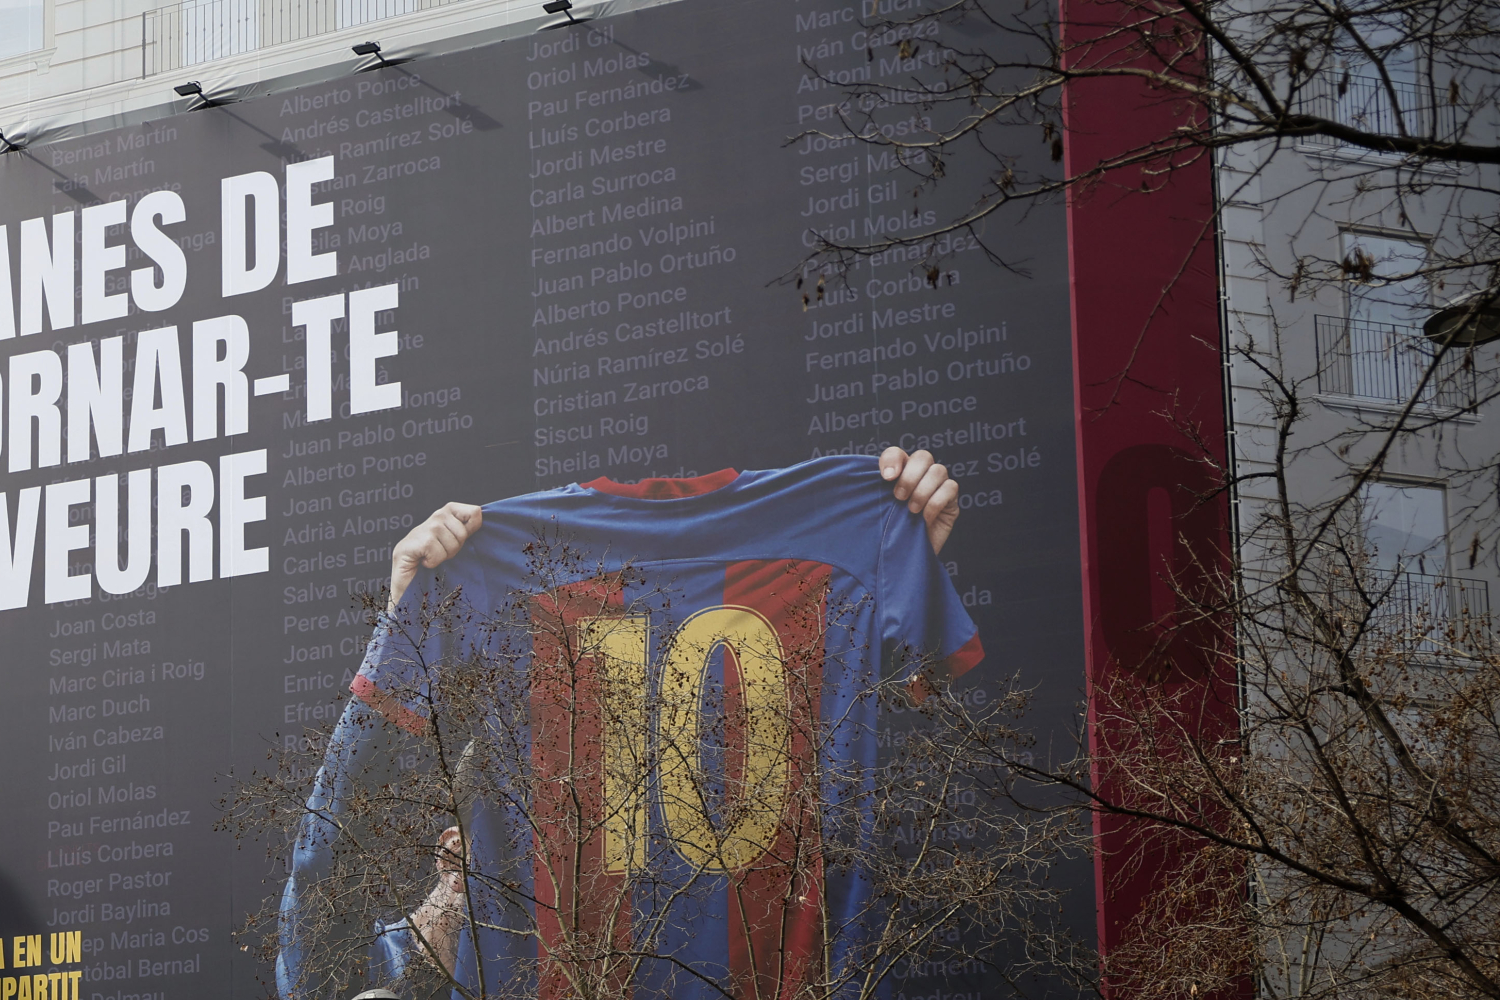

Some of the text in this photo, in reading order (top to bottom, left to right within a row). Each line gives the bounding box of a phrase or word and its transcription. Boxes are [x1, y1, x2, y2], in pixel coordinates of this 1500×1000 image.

[528, 73, 689, 119] Pau Fernández
[281, 90, 460, 143] Andrés Castelltort
[529, 108, 670, 149] Lluís Corbera
[52, 125, 176, 167] Bernat Martín
[529, 139, 666, 178] Jordi Mestre
[530, 167, 675, 207] Carla Surroca
[801, 180, 897, 216] Jordi Gil
[222, 155, 337, 297] DE
[530, 196, 682, 237] Albert Medina
[531, 215, 714, 267] Fernando Volpini
[531, 245, 736, 297] Juan Pablo Ortuño
[532, 306, 731, 356] Andrés Castelltort
[804, 300, 956, 340] Jordi Mestre
[533, 333, 744, 386] Núria Ramírez Solé
[806, 321, 1007, 372] Fernando Volpini
[806, 352, 1030, 403] Juan Pablo Ortuño
[534, 413, 648, 447] Siscu Roig
[807, 396, 976, 435] Alberto Ponce
[283, 415, 472, 458] Juan Pablo Ortuño
[282, 452, 426, 487] Alberto Ponce
[283, 480, 413, 516] Joan Garrido
[49, 609, 155, 637] Joan Costa
[49, 639, 150, 666] Sergi Mata
[49, 694, 149, 723] Marc Duch
[574, 603, 790, 876] 10
[48, 754, 125, 780] Jordi Gil
[48, 782, 156, 809] Oriol Molas
[48, 808, 190, 838] Pau Fernández
[48, 841, 172, 868] Lluís Corbera
[48, 871, 171, 899] Roger Pastor
[47, 899, 170, 926] Jordi Baylina
[13, 934, 42, 968] EN
[50, 931, 82, 965] UN
